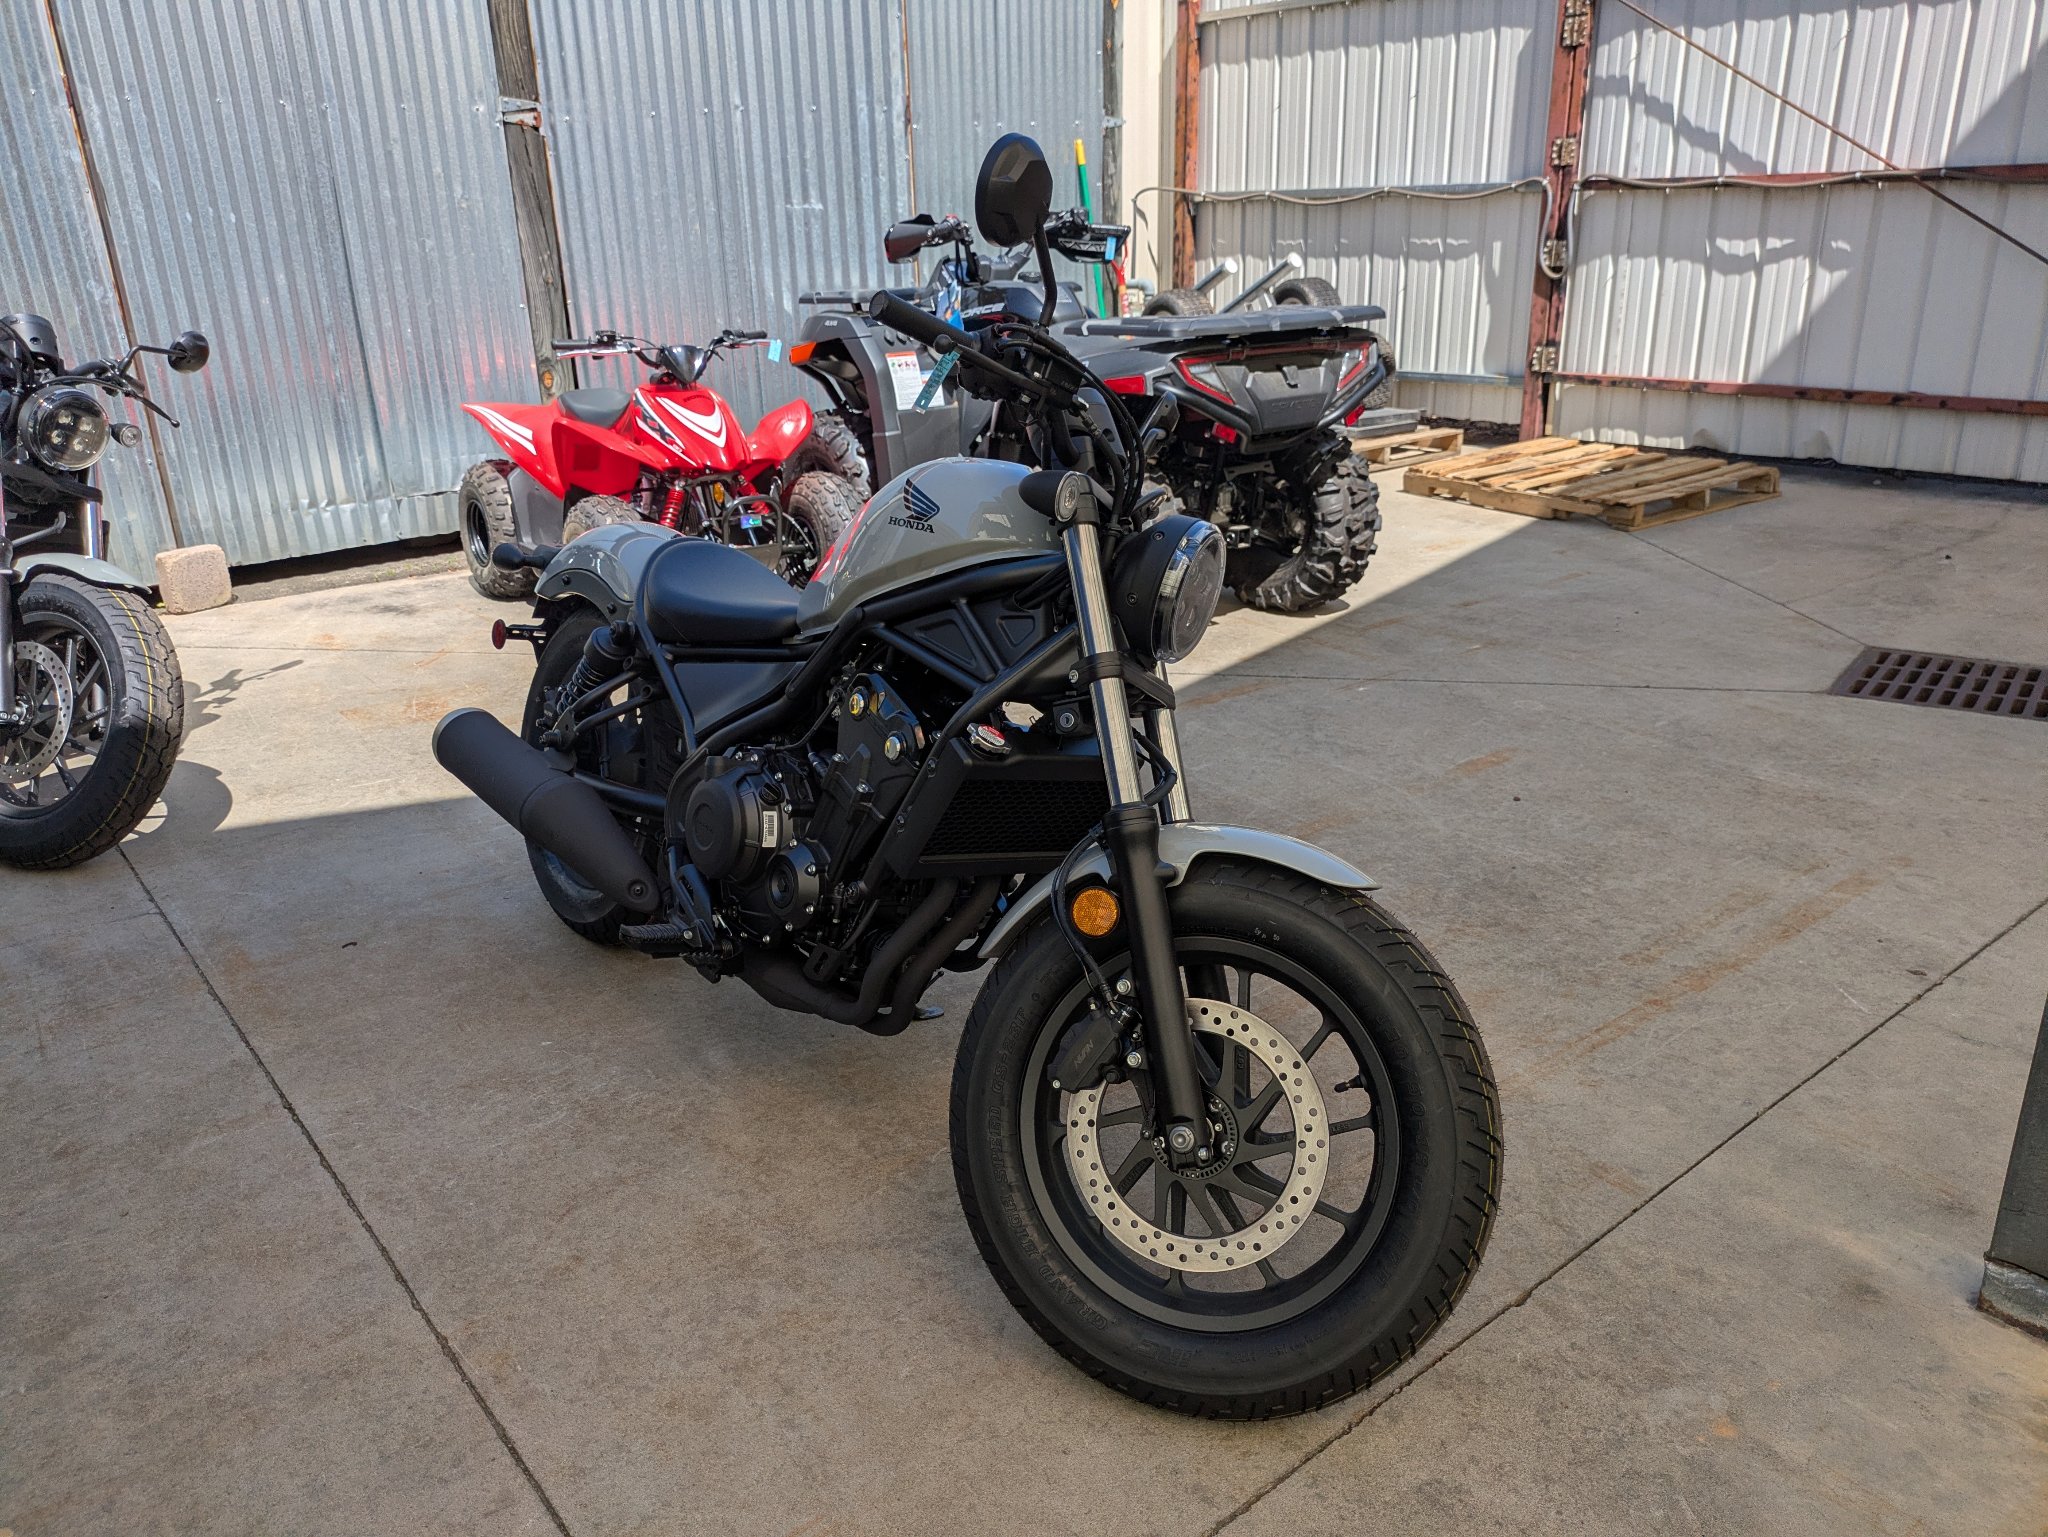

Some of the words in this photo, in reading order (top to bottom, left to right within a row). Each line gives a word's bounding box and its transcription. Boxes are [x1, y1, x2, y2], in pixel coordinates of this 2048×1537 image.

[960, 302, 1005, 318] ORCE
[888, 516, 935, 533] HONDA
[987, 1105, 1009, 1185] SPEED
[1000, 1192, 1041, 1259] HIGH
[1039, 1264, 1108, 1332] GRAND
